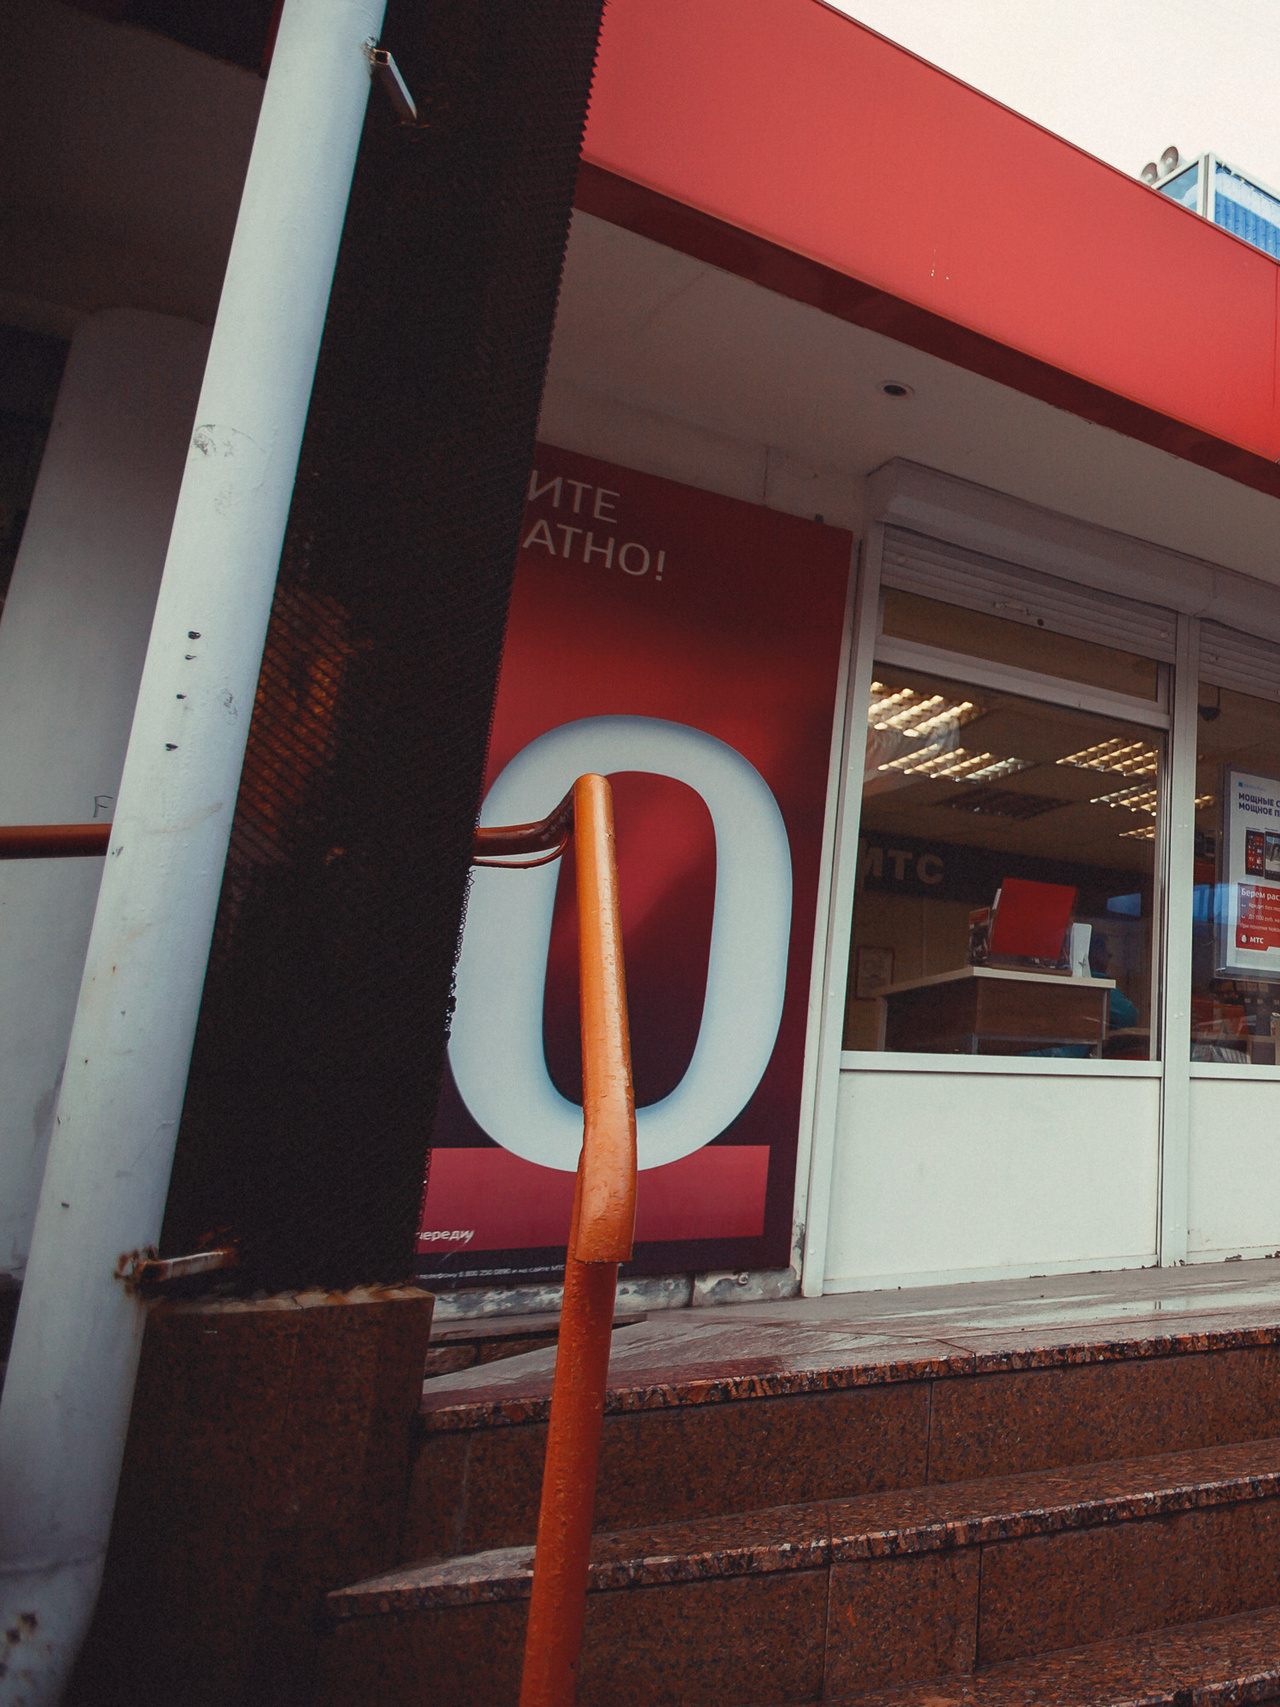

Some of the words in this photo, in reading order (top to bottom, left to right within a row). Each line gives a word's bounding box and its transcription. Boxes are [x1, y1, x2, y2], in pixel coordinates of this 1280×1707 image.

[528, 469, 620, 524] ИТЕ
[522, 518, 666, 581] АТНО!
[1238, 792, 1274, 807] МОЩНЫЕ
[1238, 802, 1273, 816] МОЩНОЕ
[1241, 888, 1266, 899] Берем
[1249, 936, 1264, 944] МТС
